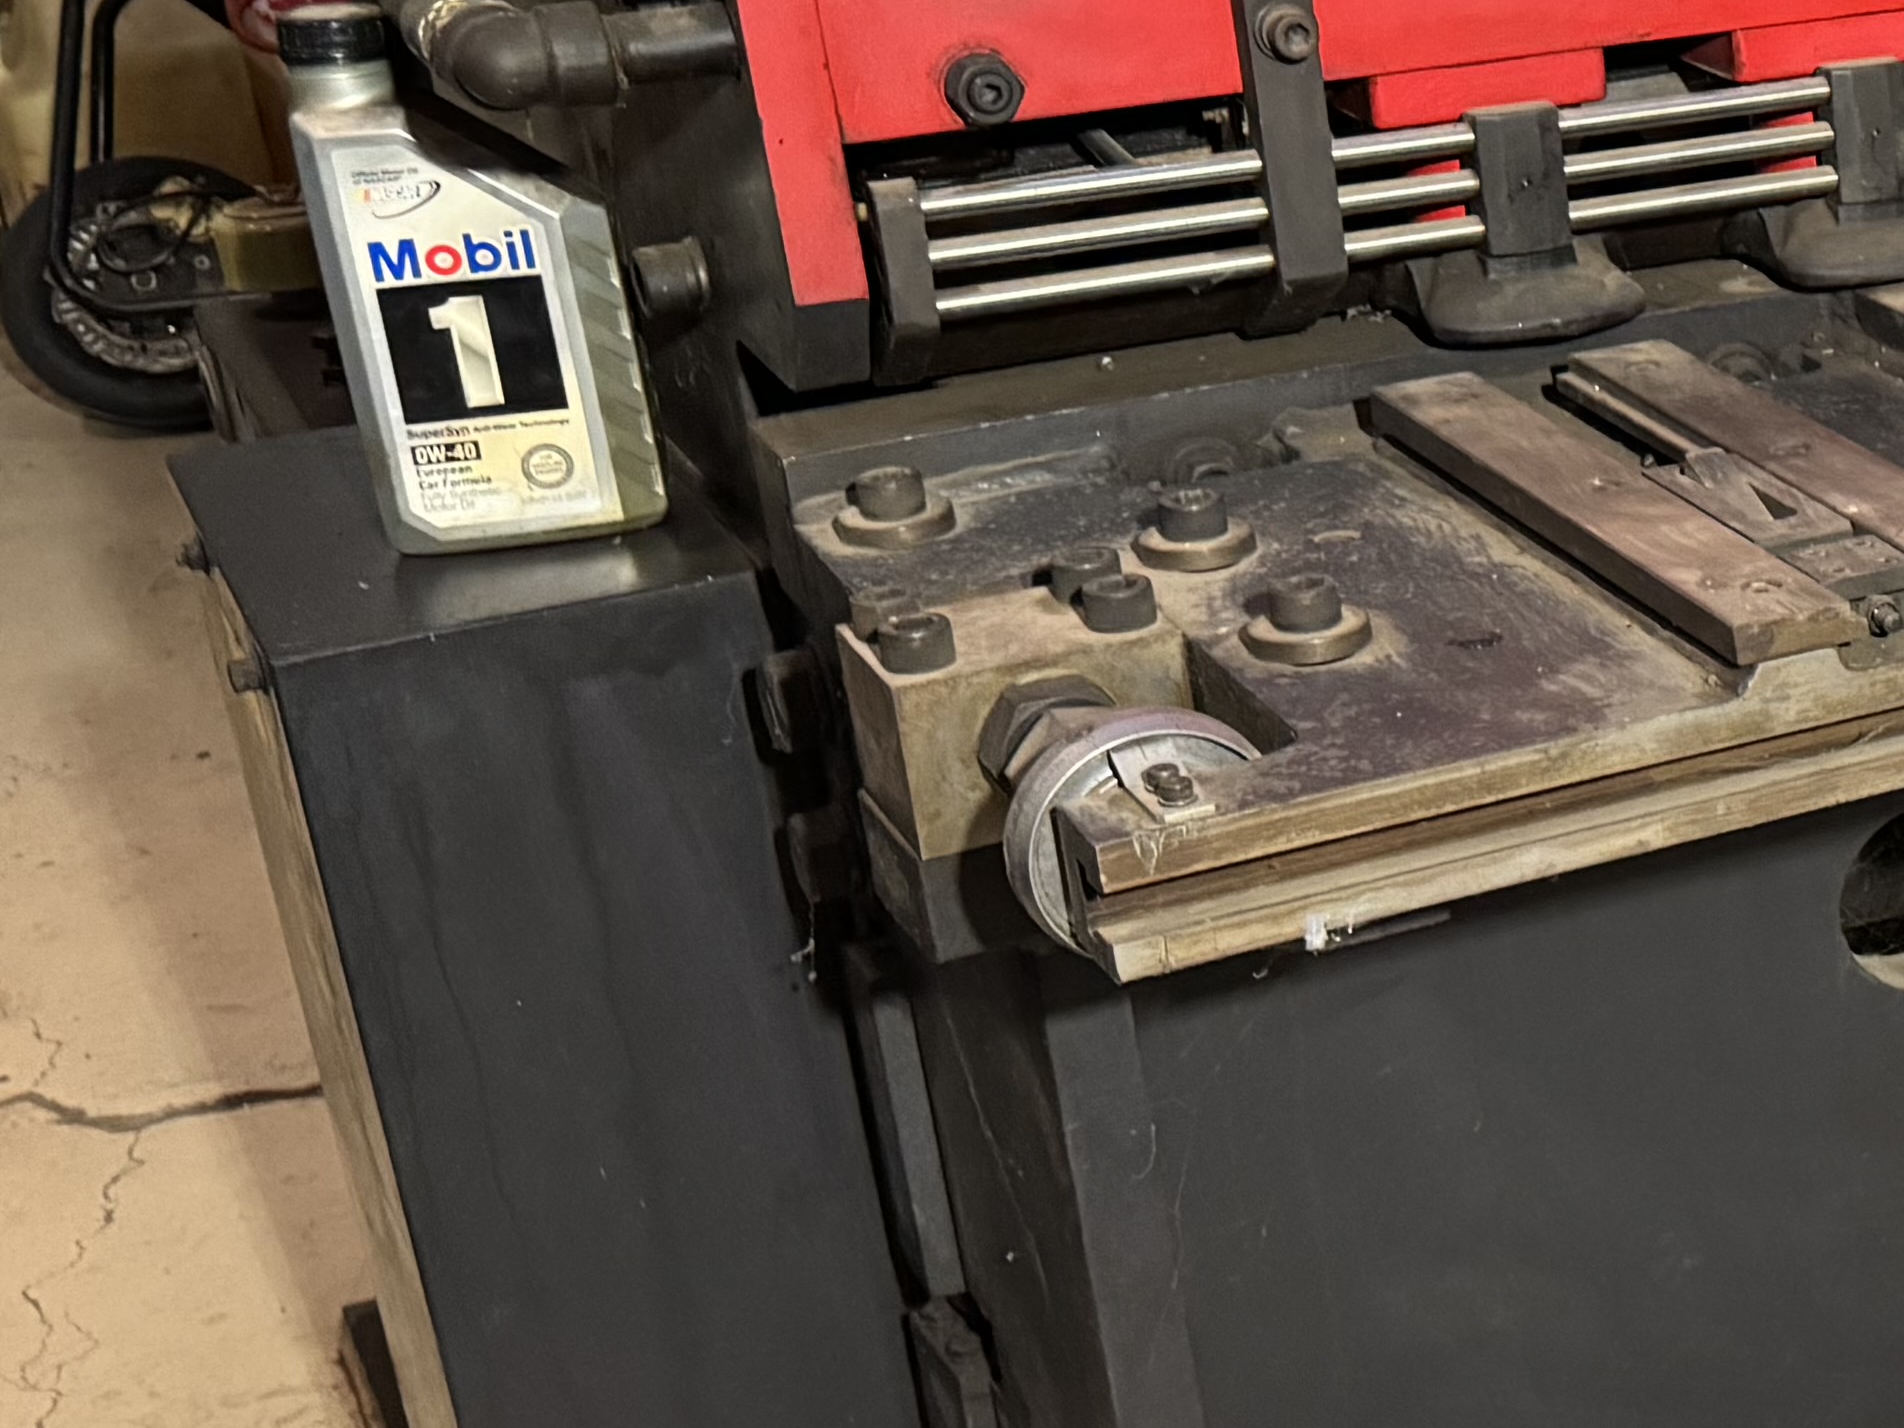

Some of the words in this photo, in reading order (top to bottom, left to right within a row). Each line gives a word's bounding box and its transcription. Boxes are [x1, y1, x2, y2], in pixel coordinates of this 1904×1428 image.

[367, 228, 537, 283] Mobil
[427, 294, 506, 409] 1
[414, 445, 477, 465] 0W-40
